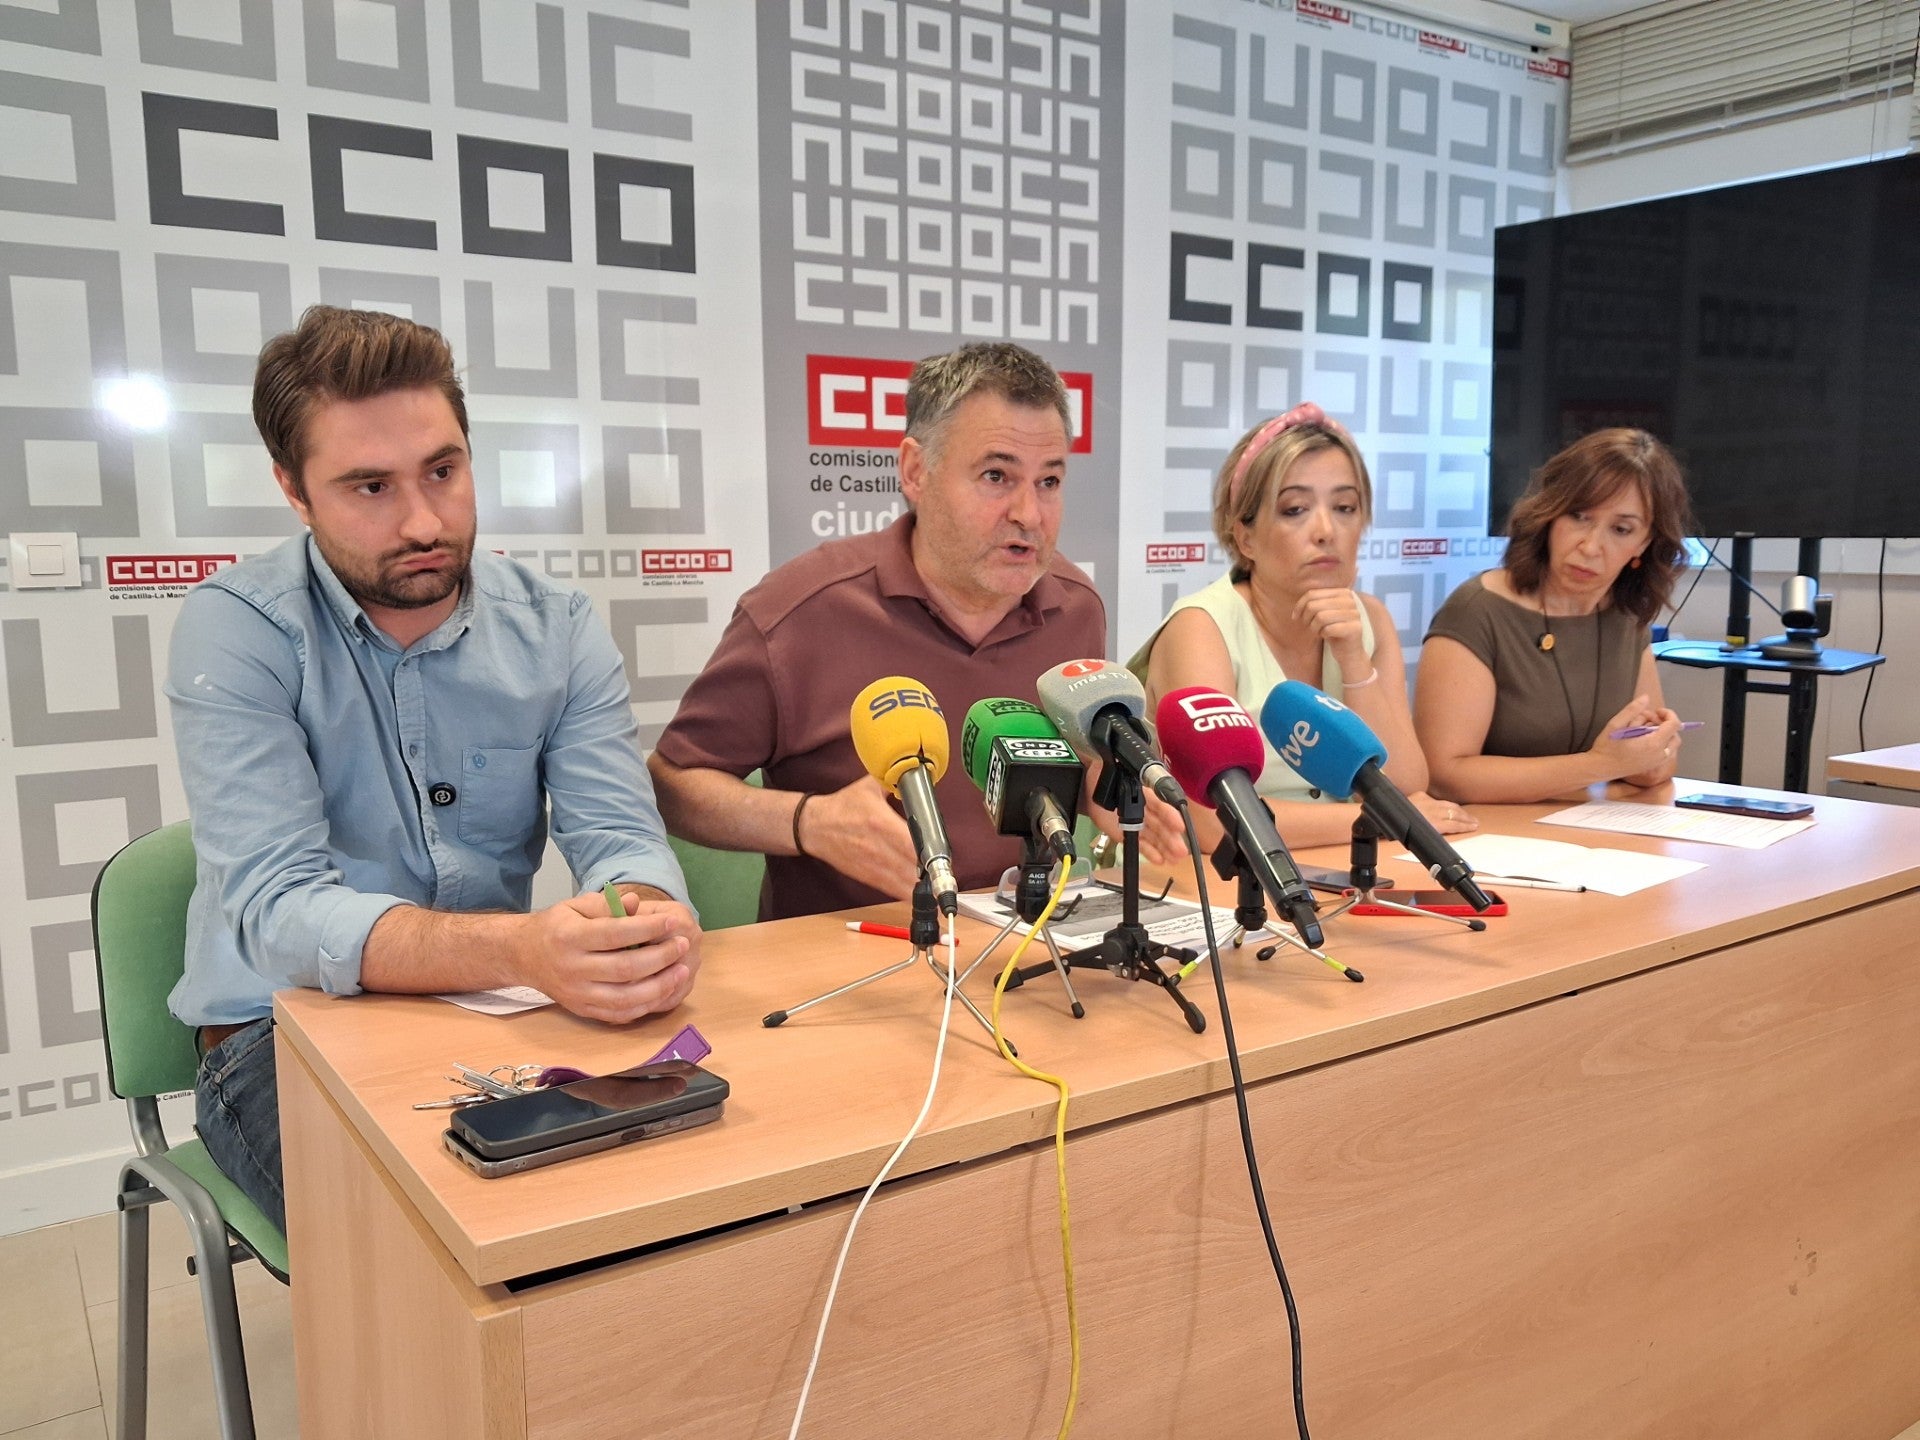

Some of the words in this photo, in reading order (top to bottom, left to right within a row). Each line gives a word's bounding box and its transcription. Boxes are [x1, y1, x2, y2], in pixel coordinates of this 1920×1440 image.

[142, 91, 697, 274] CCOO
[1169, 231, 1434, 343] CCOO
[809, 451, 899, 468] comision
[811, 475, 833, 492] de
[811, 502, 899, 536] ciud
[645, 553, 705, 570] CCOO
[1147, 546, 1188, 560] CCOO
[111, 561, 199, 579] CCOO
[1193, 713, 1254, 732] cmm
[1014, 740, 1060, 749] ONDA
[1280, 720, 1320, 767] tve
[163, 1091, 194, 1101] Castilla-
